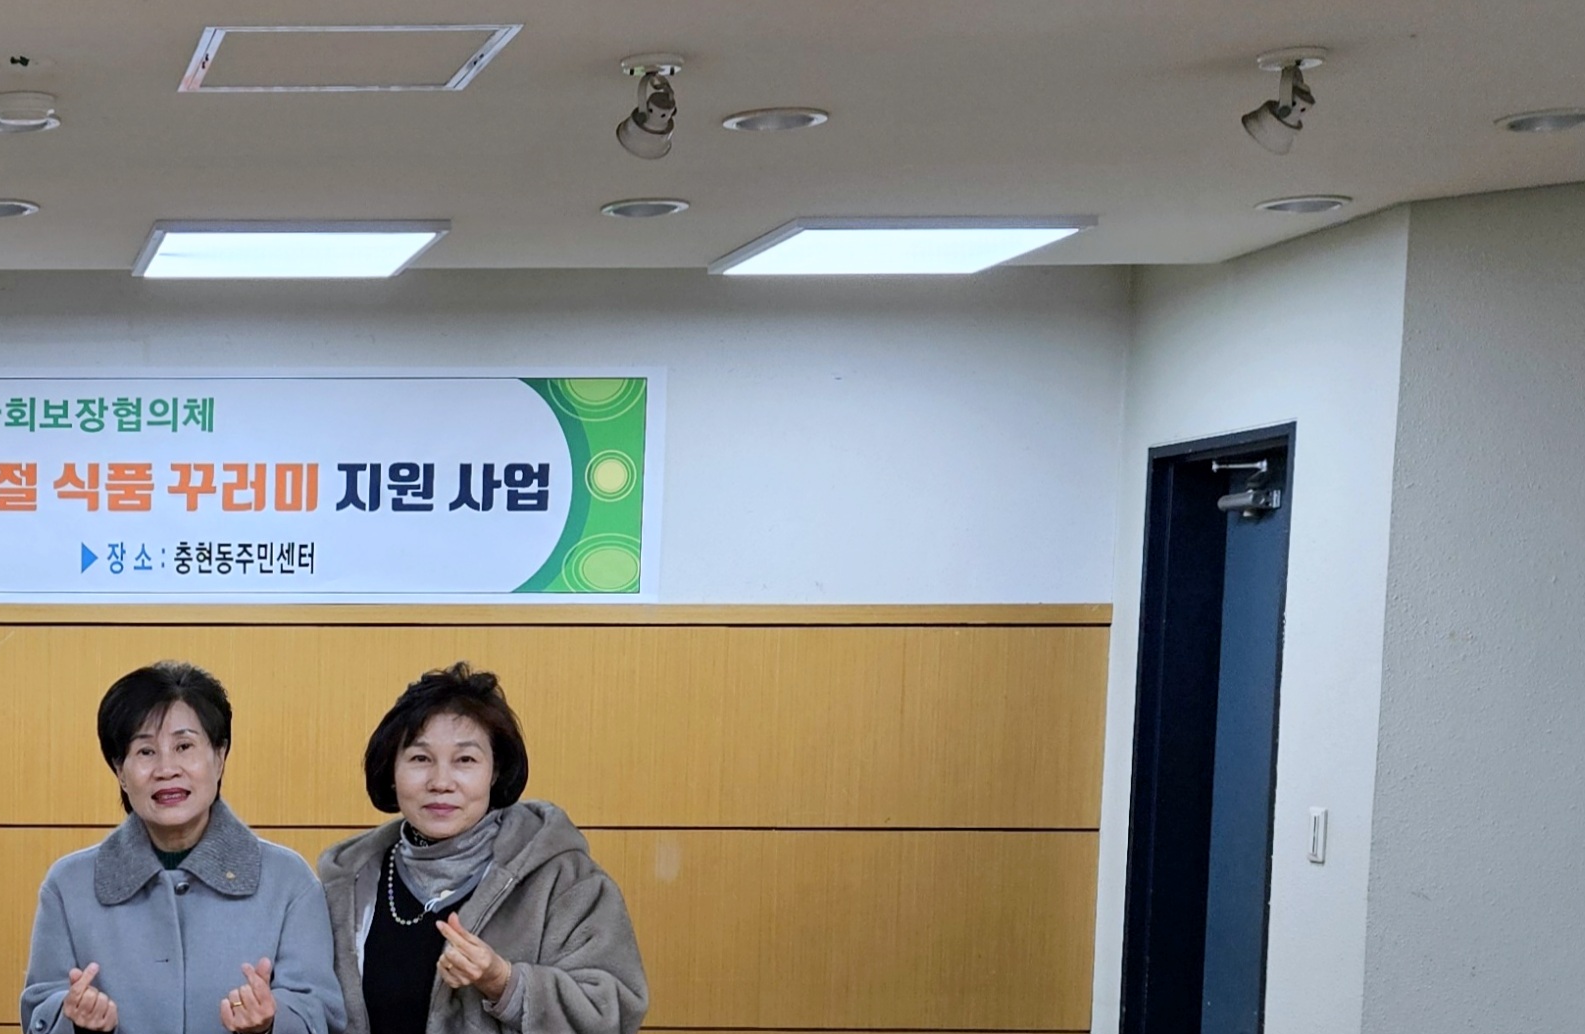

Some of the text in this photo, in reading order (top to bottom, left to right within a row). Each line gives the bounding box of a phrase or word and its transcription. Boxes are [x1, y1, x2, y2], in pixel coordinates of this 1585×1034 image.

[53, 462, 155, 512] 식품
[167, 462, 319, 512] 꾸러미
[335, 462, 434, 512] 지원
[448, 462, 551, 512] 사업
[174, 541, 316, 575] 충현동주민센터
